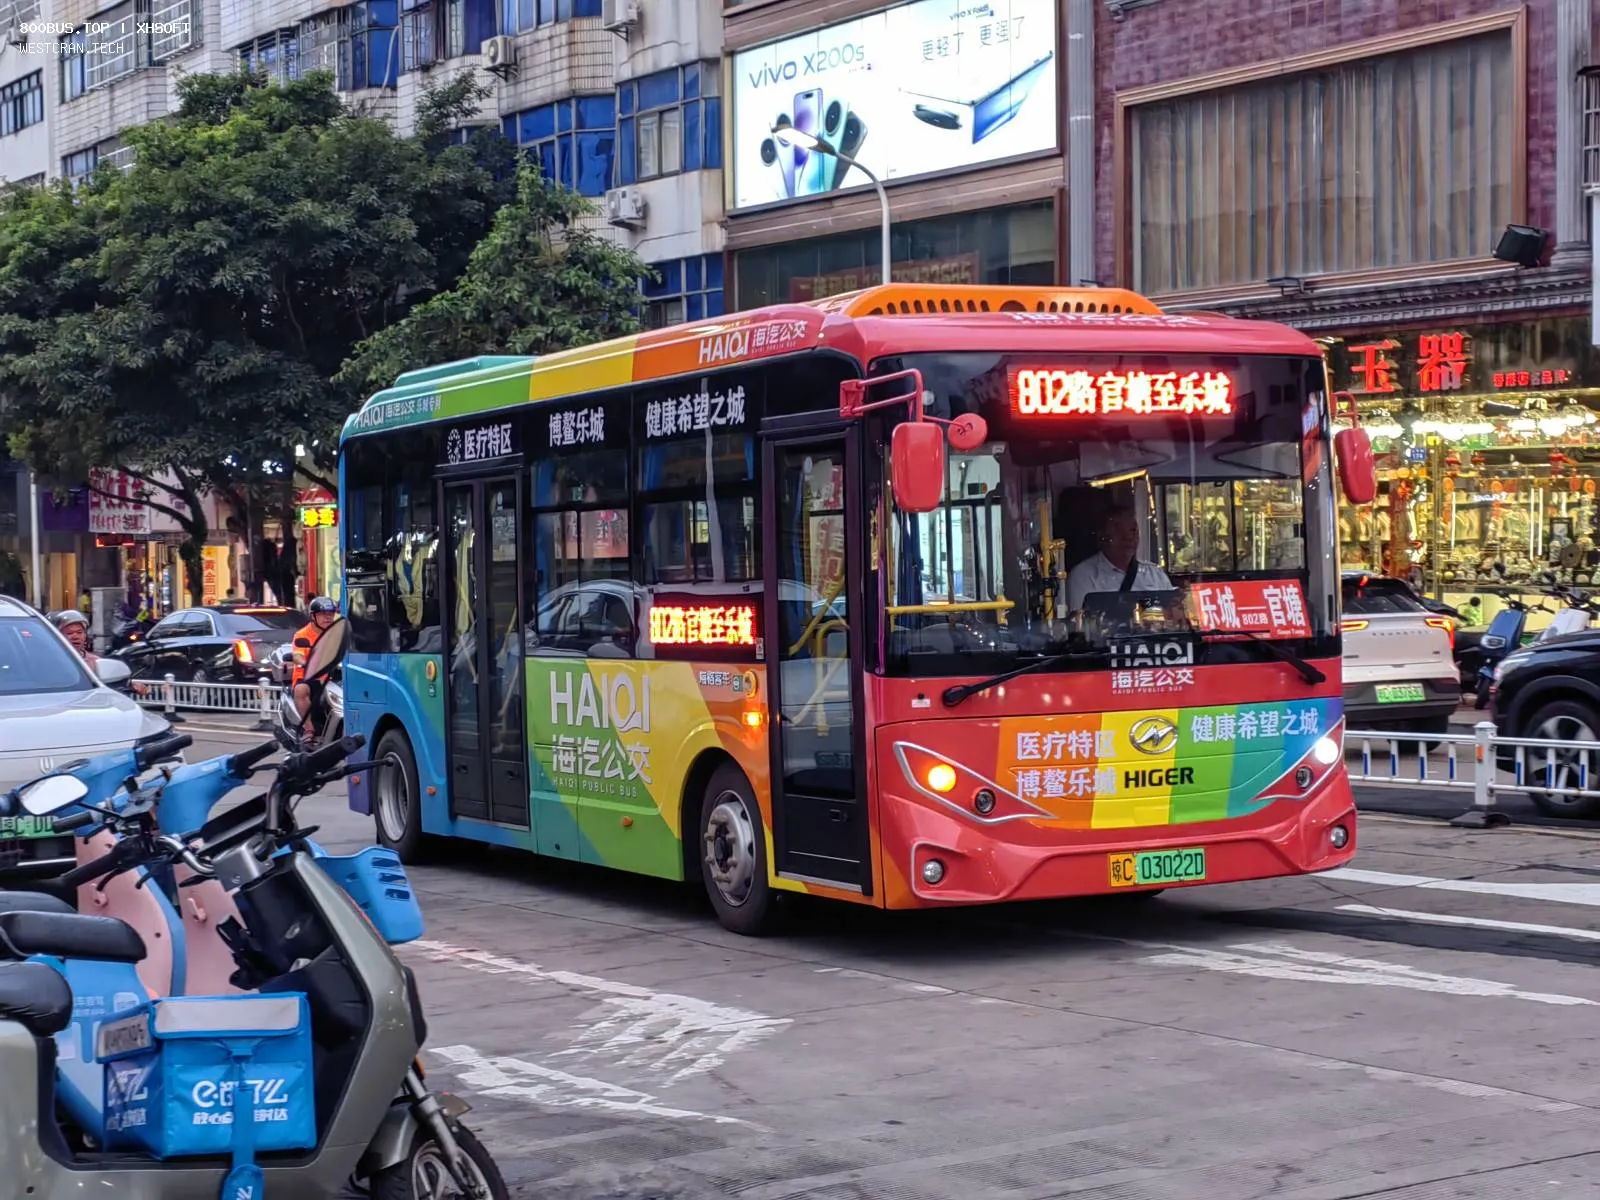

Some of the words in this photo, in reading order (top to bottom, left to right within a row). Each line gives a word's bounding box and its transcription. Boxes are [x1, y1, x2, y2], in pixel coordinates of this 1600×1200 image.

[749, 61, 797, 89] vivo
[803, 43, 865, 76] X200s
[699, 328, 750, 364] HAIQI
[752, 320, 808, 347] 海汽公交
[1348, 331, 1466, 393] 玉器
[549, 406, 605, 447] 博鳌乐城
[645, 385, 746, 438] 健康希望之城
[464, 422, 512, 460] 医疗特区
[1199, 586, 1241, 630] 乐城
[1263, 584, 1306, 627] 官塘
[1111, 642, 1194, 668] HAIQI
[1112, 668, 1195, 689] 海汽公交
[550, 670, 650, 733] HAIQI
[1191, 707, 1319, 744] 健康希望之城
[552, 734, 652, 784] 海汽公交
[1016, 729, 1116, 761] 医疗特区
[553, 776, 578, 789] HAIQI
[582, 780, 615, 794] PUBLIC
[619, 785, 637, 797] BUS
[1016, 766, 1116, 800] 博鳌乐城
[1124, 766, 1194, 789] HIGER
[1142, 852, 1204, 880] 03022D
